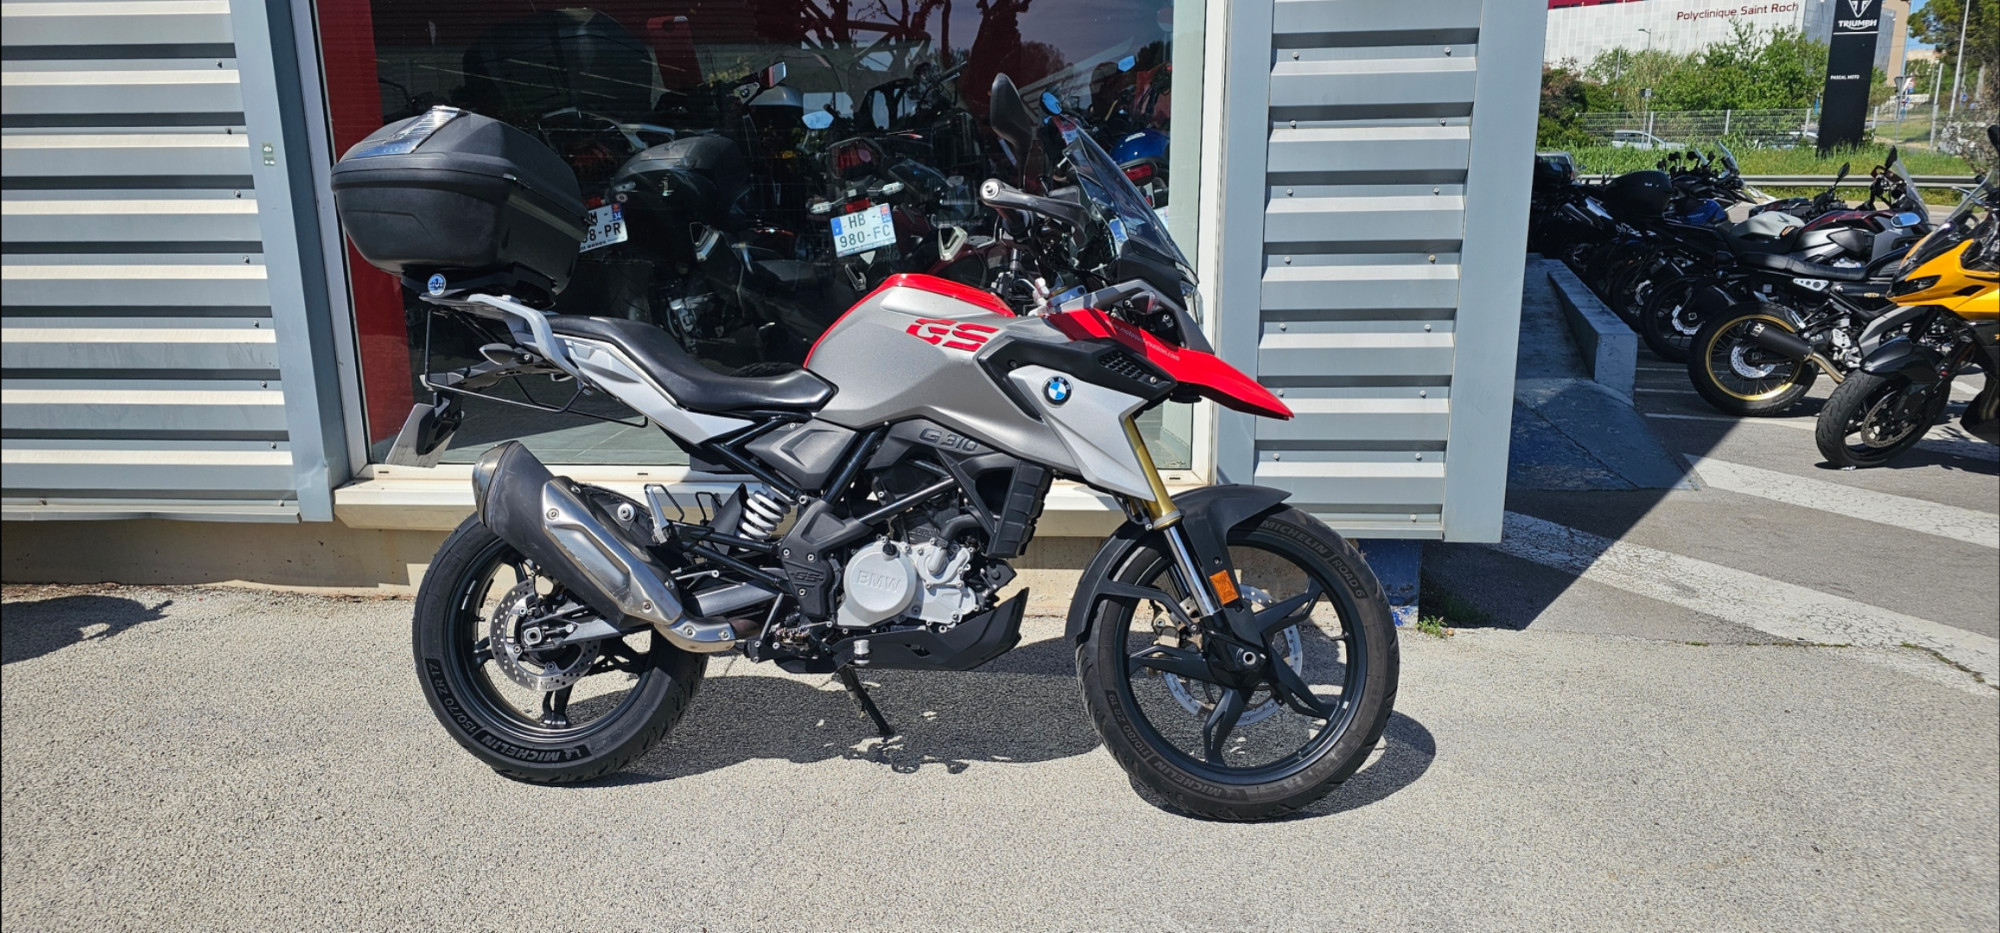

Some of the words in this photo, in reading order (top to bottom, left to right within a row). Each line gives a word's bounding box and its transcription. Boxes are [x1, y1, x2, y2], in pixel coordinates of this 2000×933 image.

[1676, 7, 1737, 21] Polyclinique
[1740, 5, 1767, 15] Saint
[1771, 2, 1799, 13] Roch
[1838, 19, 1877, 30] TRIUMPH
[848, 213, 866, 229] HB
[839, 224, 891, 248] 980-FC
[906, 318, 999, 352] GS
[919, 428, 942, 444] G
[941, 433, 978, 452] 310
[1261, 520, 1329, 555] MICHELIN
[1331, 559, 1360, 587] ROAD
[1355, 589, 1366, 599] 6
[856, 569, 901, 593] BMW
[430, 663, 441, 676] 17
[434, 680, 449, 695] ZR
[444, 697, 477, 734] 150/70
[481, 734, 561, 761] MICHELIN
[1122, 724, 1149, 757] 110/80
[1154, 761, 1222, 797] MICHELIN
